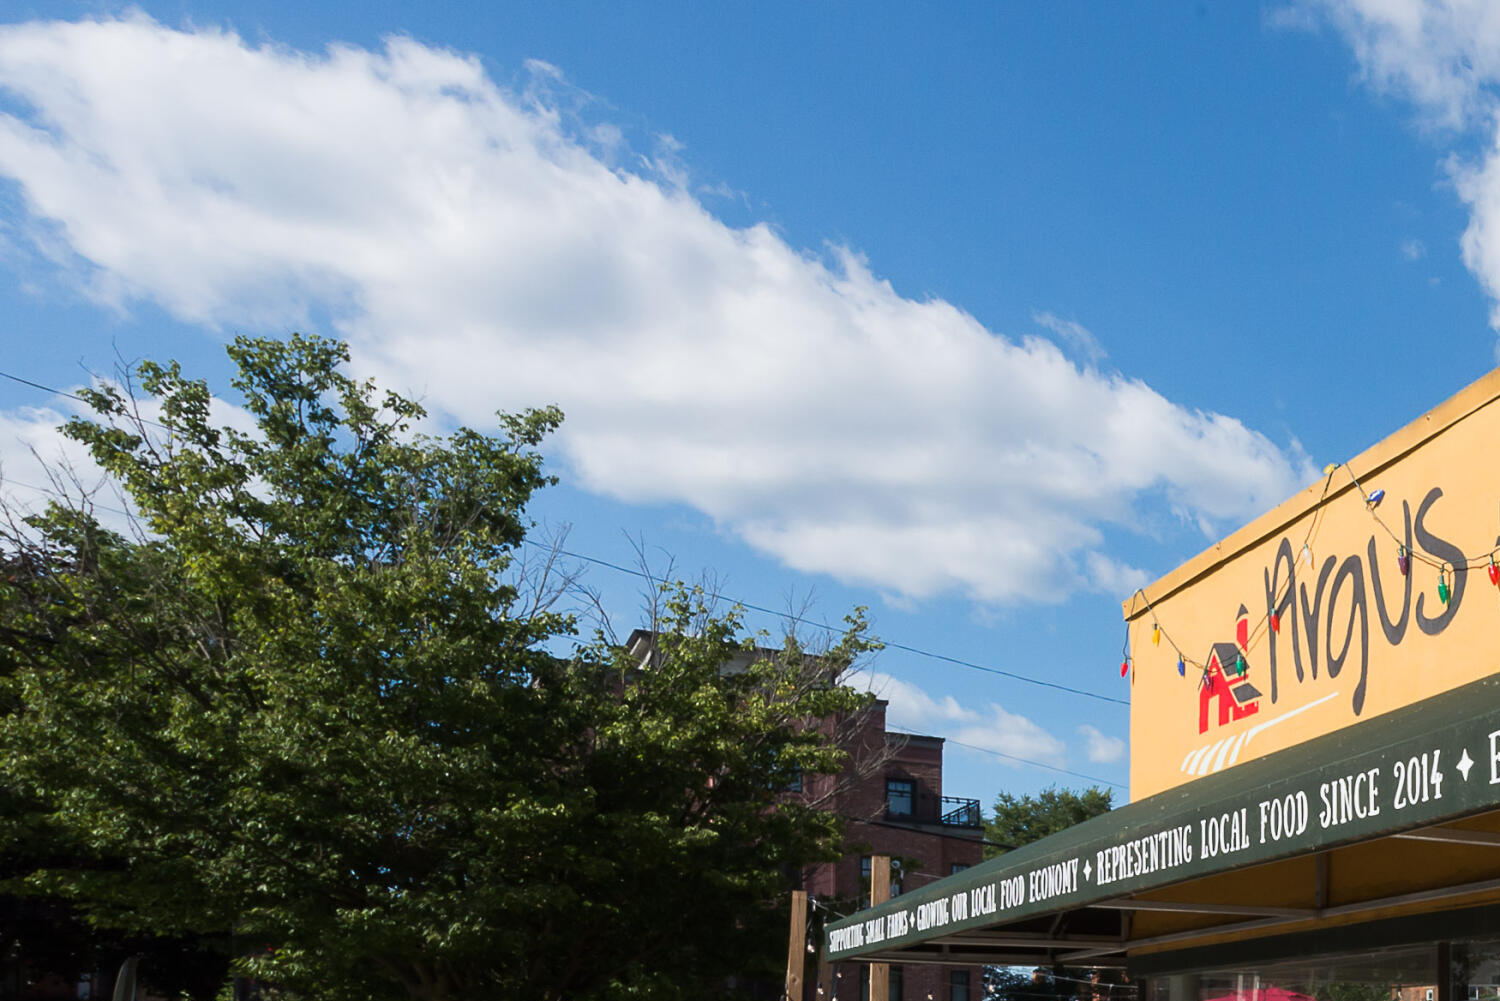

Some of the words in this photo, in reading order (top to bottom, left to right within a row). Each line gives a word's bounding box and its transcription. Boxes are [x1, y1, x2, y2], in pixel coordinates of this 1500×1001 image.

[829, 922, 864, 953] SUPPORTING
[865, 916, 885, 944] SMALL
[886, 909, 909, 939] FARMS
[917, 897, 949, 931] GROWING
[951, 892, 968, 922] OUR
[971, 883, 997, 917] LOCAL
[1000, 875, 1025, 910] FOOD
[1029, 857, 1079, 903] ECONOMY
[1096, 824, 1193, 885] REPRESENTING
[1200, 808, 1250, 860] LOCAL
[1259, 790, 1309, 844] FOOD
[1319, 767, 1380, 829] SINCE
[1393, 748, 1443, 810] 2014
